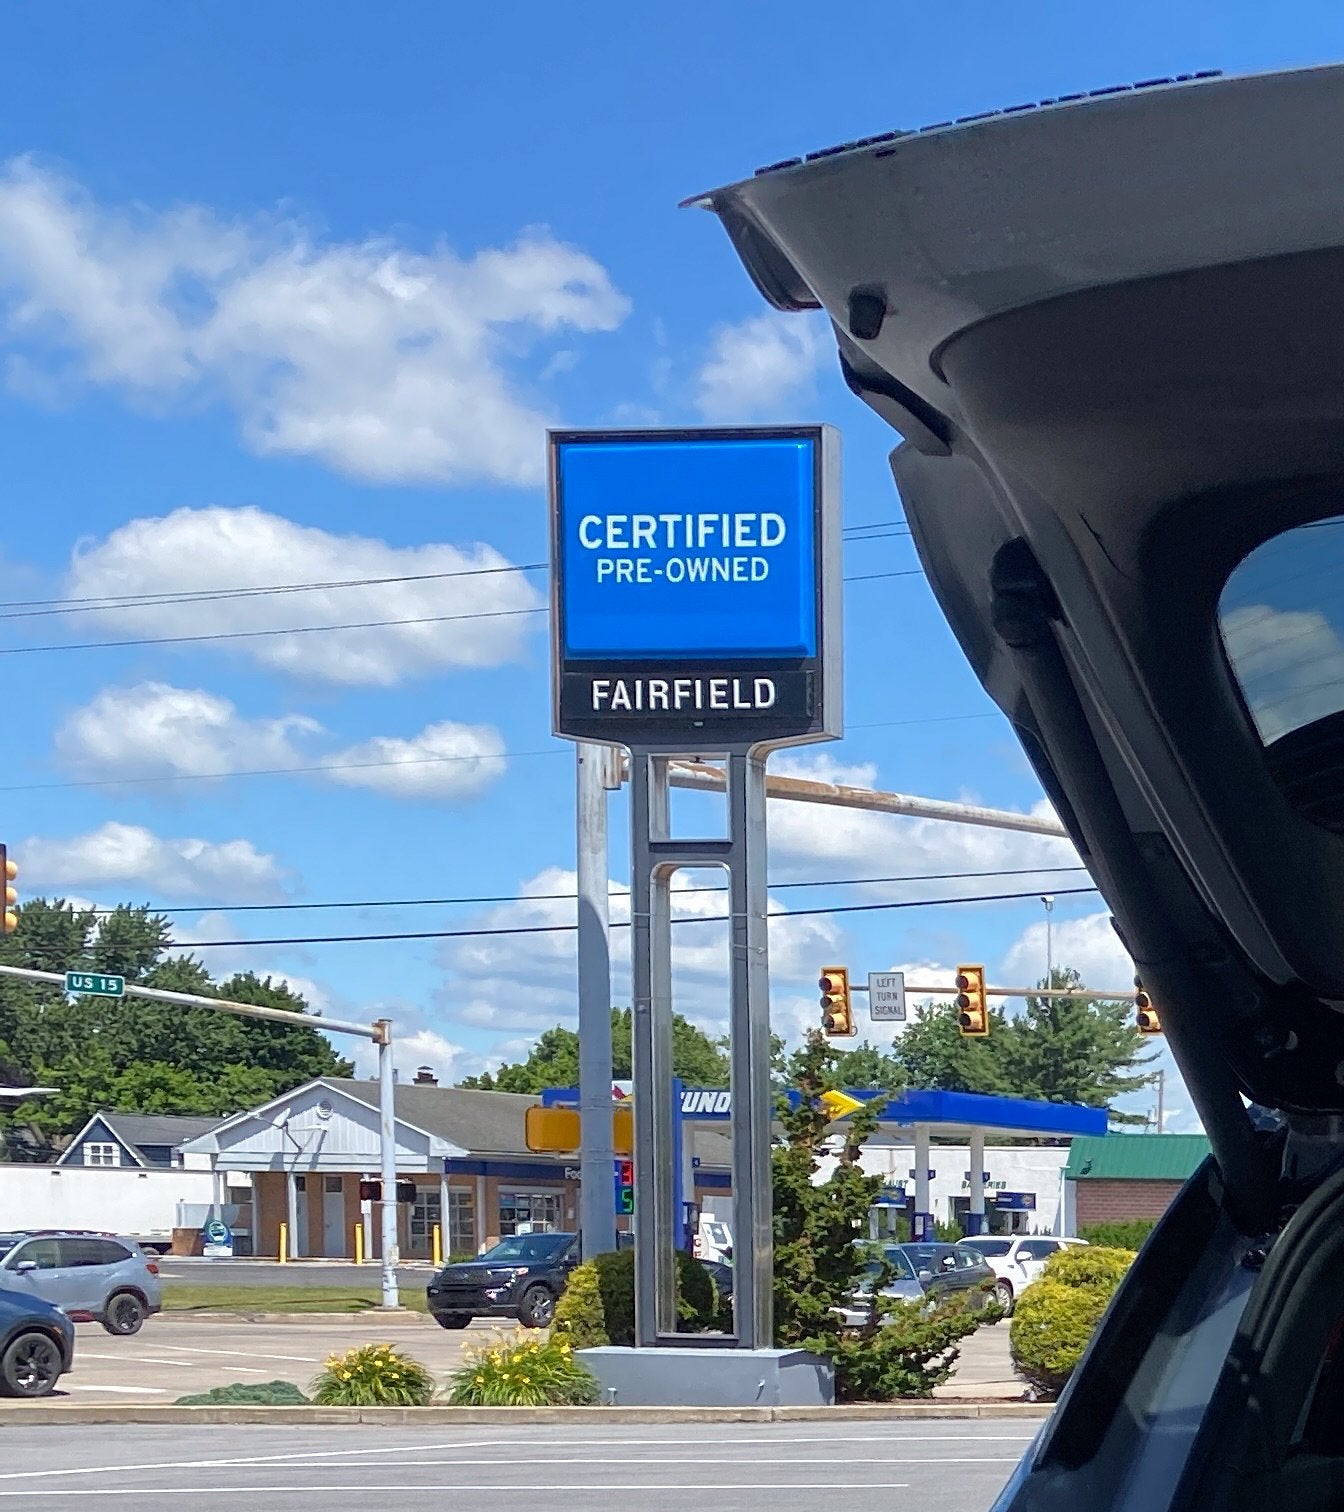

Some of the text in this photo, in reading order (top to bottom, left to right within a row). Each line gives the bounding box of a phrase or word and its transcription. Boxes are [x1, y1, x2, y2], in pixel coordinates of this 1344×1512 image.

[578, 512, 787, 549] CERTIFIED
[596, 556, 770, 583] PRE-OWNED
[591, 678, 777, 711] FAIRFIELD
[72, 976, 118, 991] US 15
[876, 977, 896, 988] LEFT
[876, 991, 898, 1001] TURN
[874, 1005, 903, 1016] SIGNAL
[680, 1091, 731, 1113] UNO
[564, 1166, 583, 1180] Foo
[621, 1188, 633, 1213] 5
